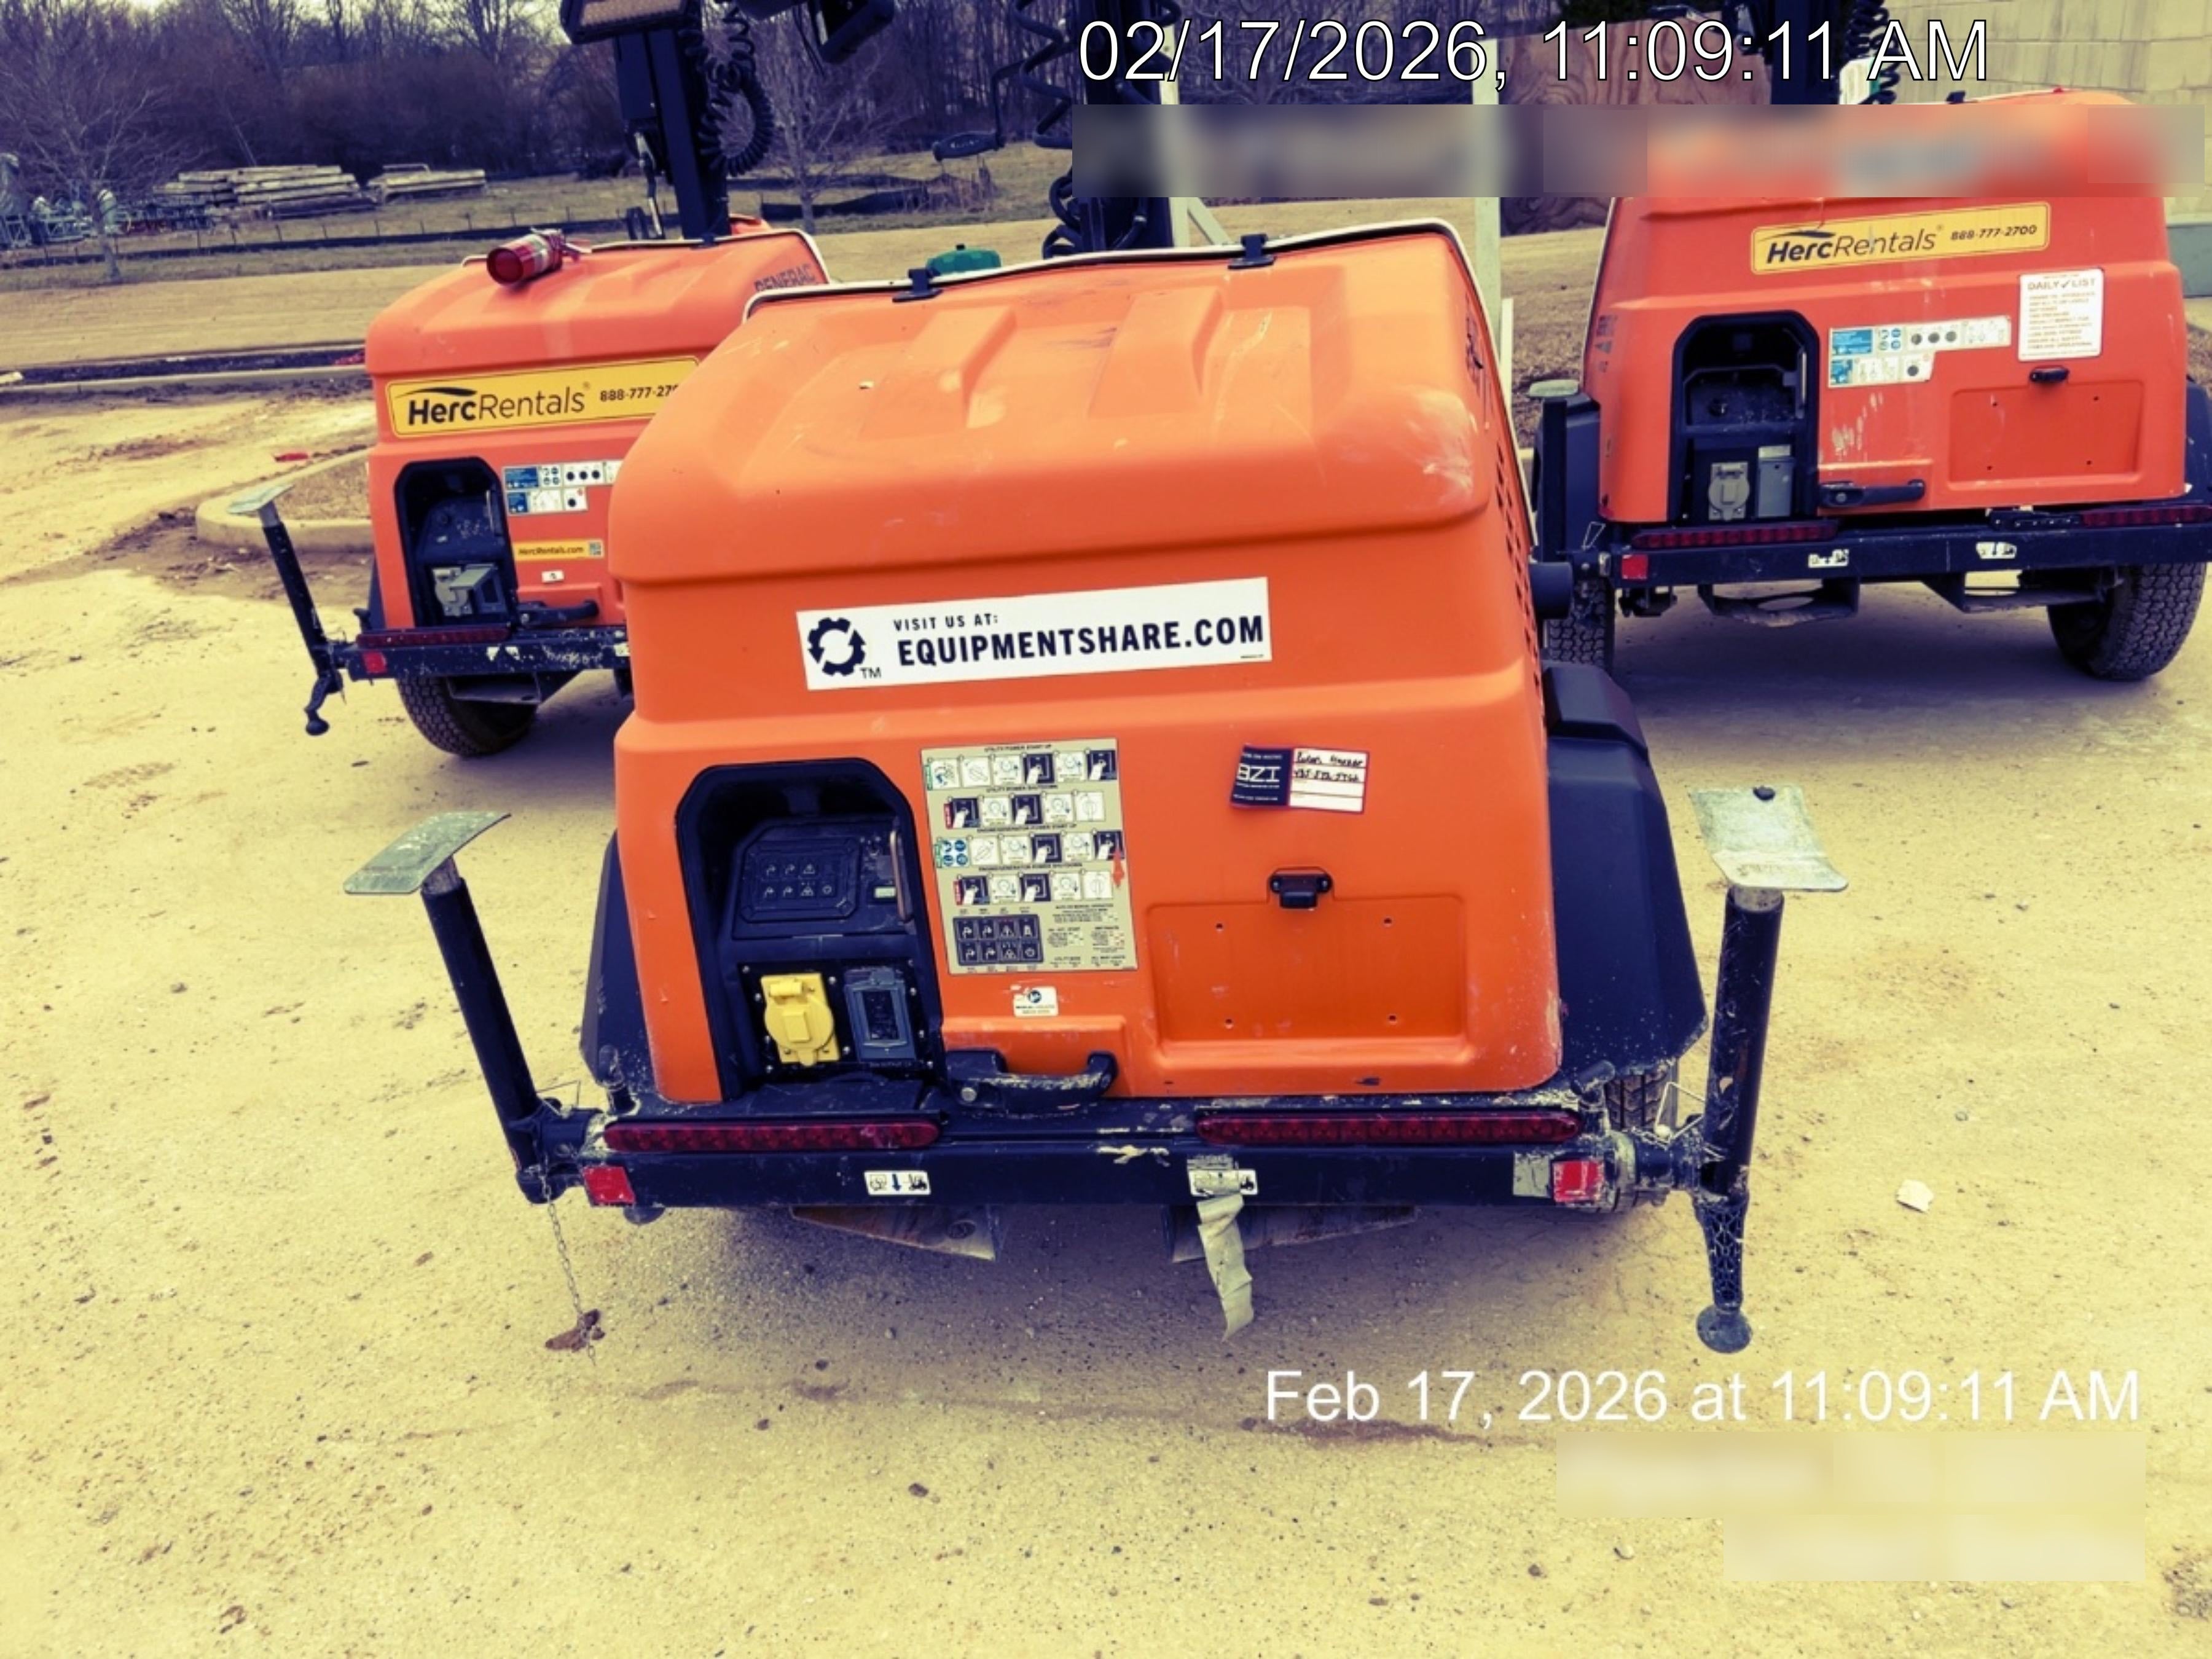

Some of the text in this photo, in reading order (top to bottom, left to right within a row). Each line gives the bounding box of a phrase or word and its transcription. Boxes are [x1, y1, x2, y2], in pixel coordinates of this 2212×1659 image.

[1767, 224, 2037, 263] HercRentals 888-777-2700
[2028, 278, 2095, 290] DAILY LIST
[409, 386, 586, 426] HercRentals
[893, 613, 999, 632] VISIT US AT:
[897, 614, 1264, 666] EQUIPMENTSHARE.COM
[861, 667, 882, 678] TM
